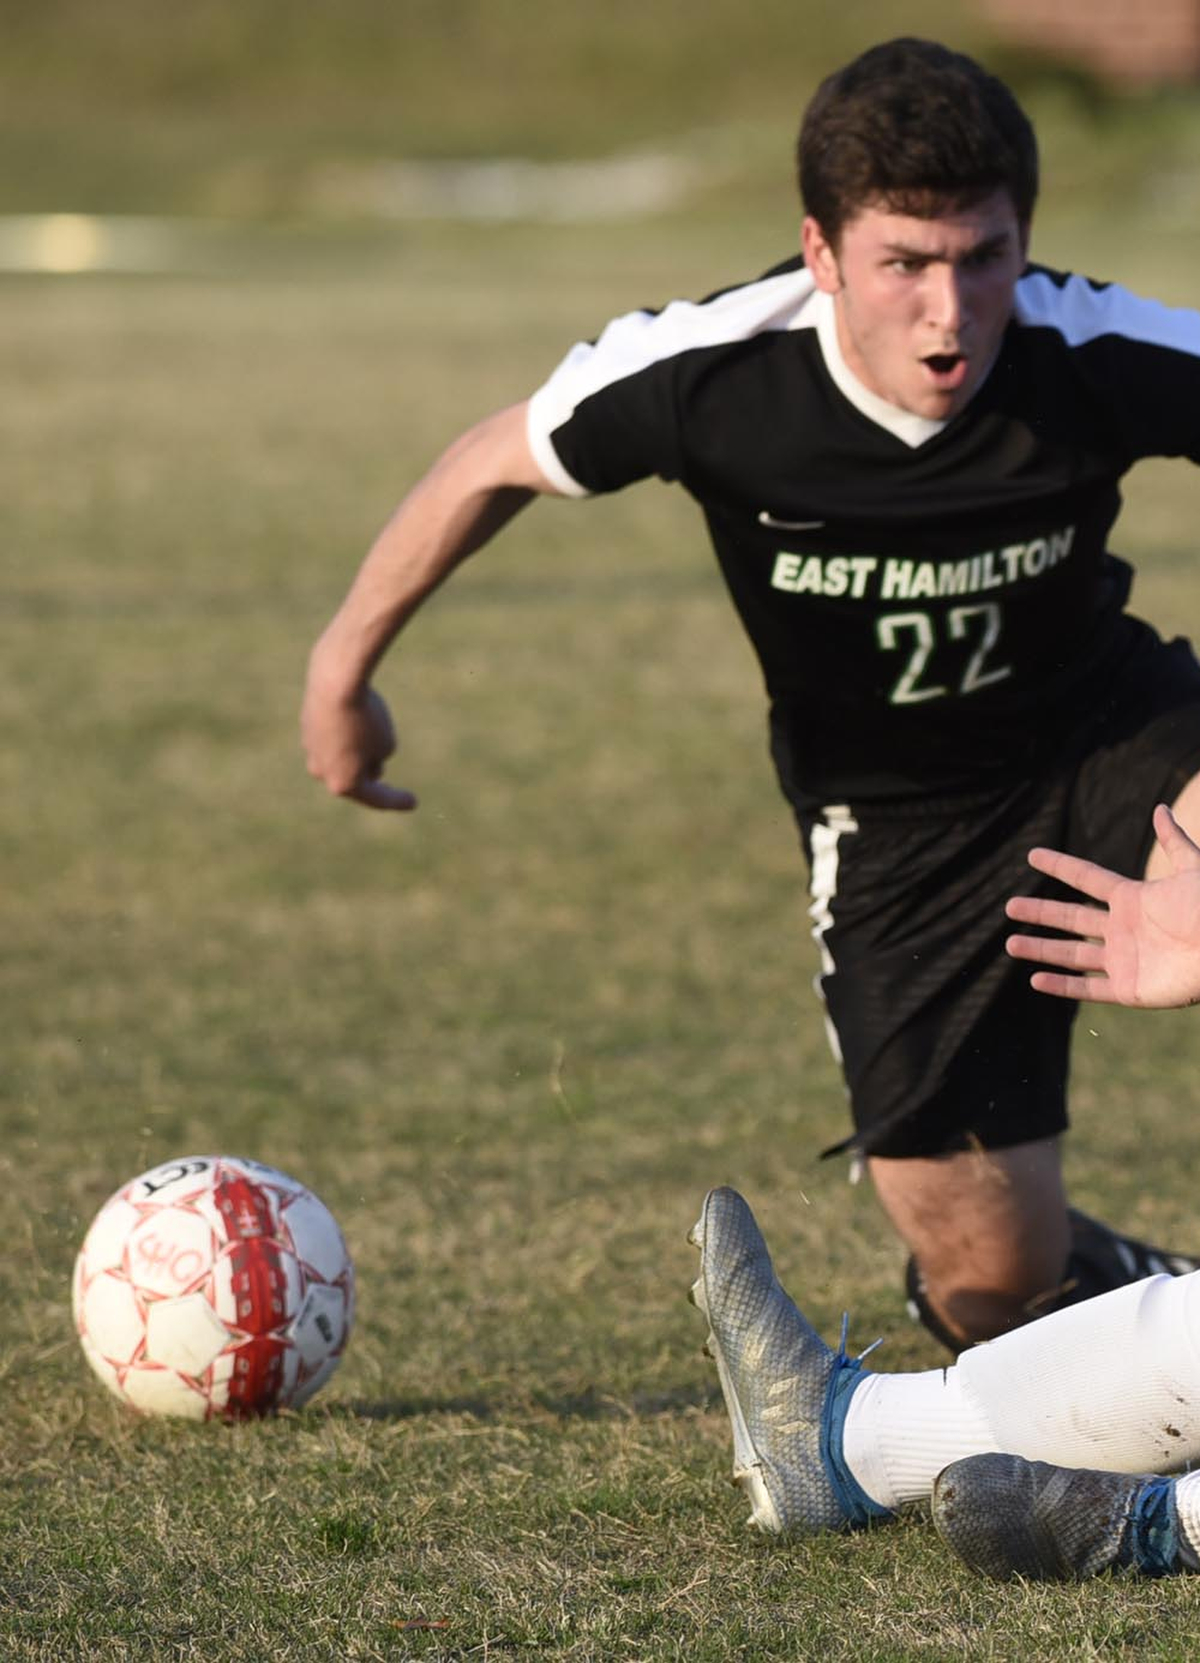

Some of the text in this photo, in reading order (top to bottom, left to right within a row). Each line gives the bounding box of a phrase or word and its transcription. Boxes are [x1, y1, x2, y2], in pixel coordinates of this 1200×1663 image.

[771, 525, 1076, 599] EAST HAMILTON
[877, 602, 1012, 704] 22
